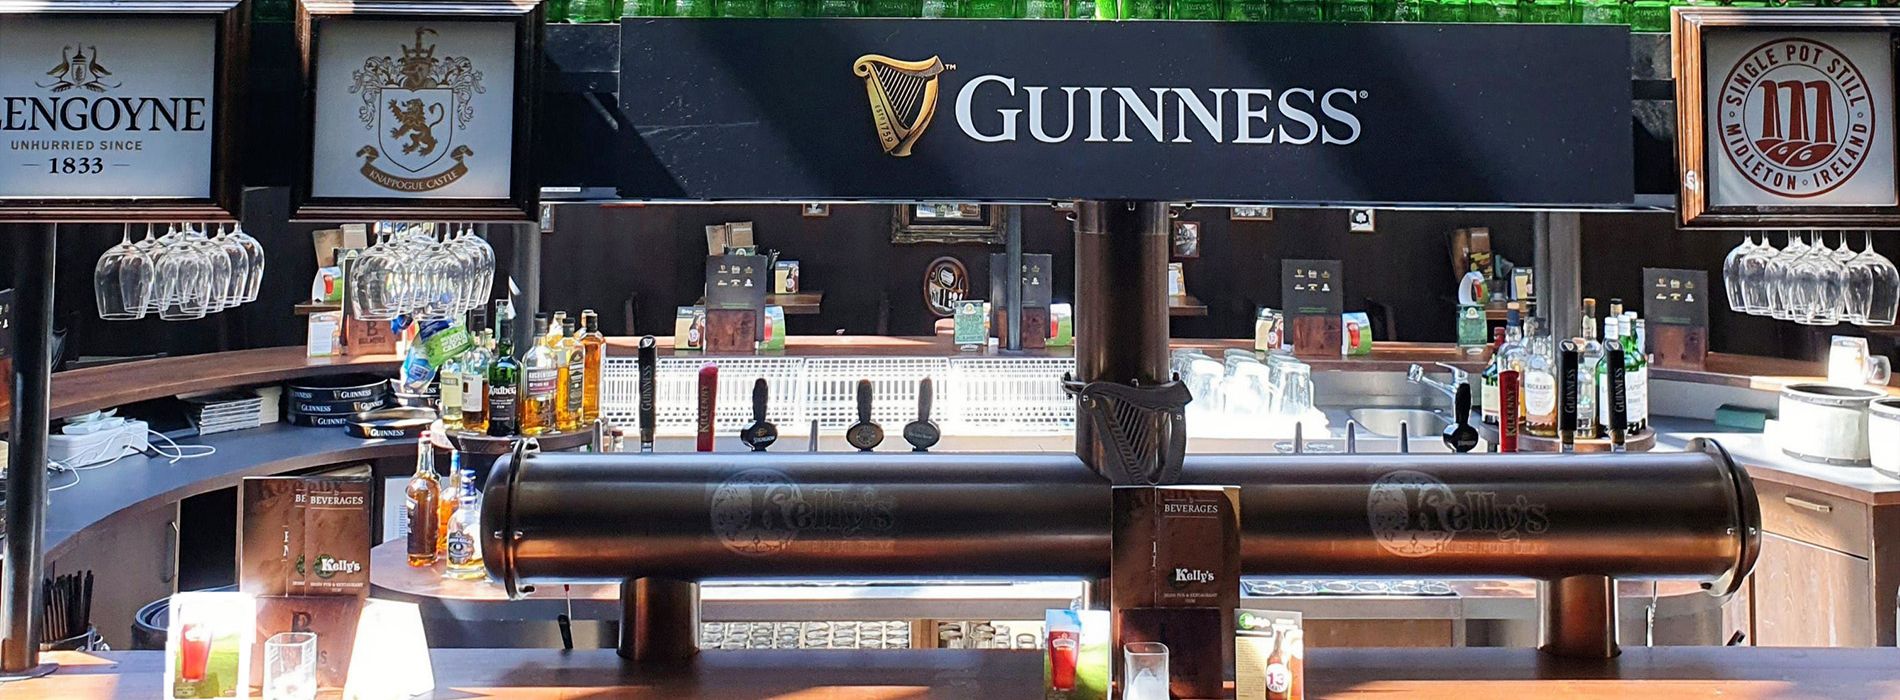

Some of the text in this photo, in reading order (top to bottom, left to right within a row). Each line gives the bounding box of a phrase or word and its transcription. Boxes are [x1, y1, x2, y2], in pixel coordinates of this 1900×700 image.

[1726, 44, 1865, 107] SINGLE POT STILL
[0, 97, 206, 132] ENGOYNE
[955, 74, 1362, 145] GUINNESS
[880, 122, 894, 143] 1759
[11, 140, 143, 151] UNHURRIED SINCE
[49, 157, 104, 174] 1833
[1726, 123, 1867, 190] MIDLETON IRELAND
[369, 169, 458, 190] KNAPPOGUE CASTLE
[340, 389, 372, 399] GUINNESS
[640, 364, 653, 412] GUINNESS
[1564, 367, 1576, 414] GUINNESS
[1614, 366, 1626, 413] GUINNESS
[301, 403, 332, 412] GUINNESS
[699, 384, 710, 433] KILKENNY
[1506, 389, 1516, 436] KILKENNY
[317, 417, 347, 426] GUINNE
[370, 428, 405, 437] GUINNESS
[310, 496, 364, 505] BEVERAGES
[1164, 504, 1218, 514] BEVERAGES
[1405, 487, 1550, 542] Kelly's
[321, 558, 361, 573] Kelly's
[1175, 568, 1215, 583] Kelly's
[1268, 671, 1285, 686] 13
